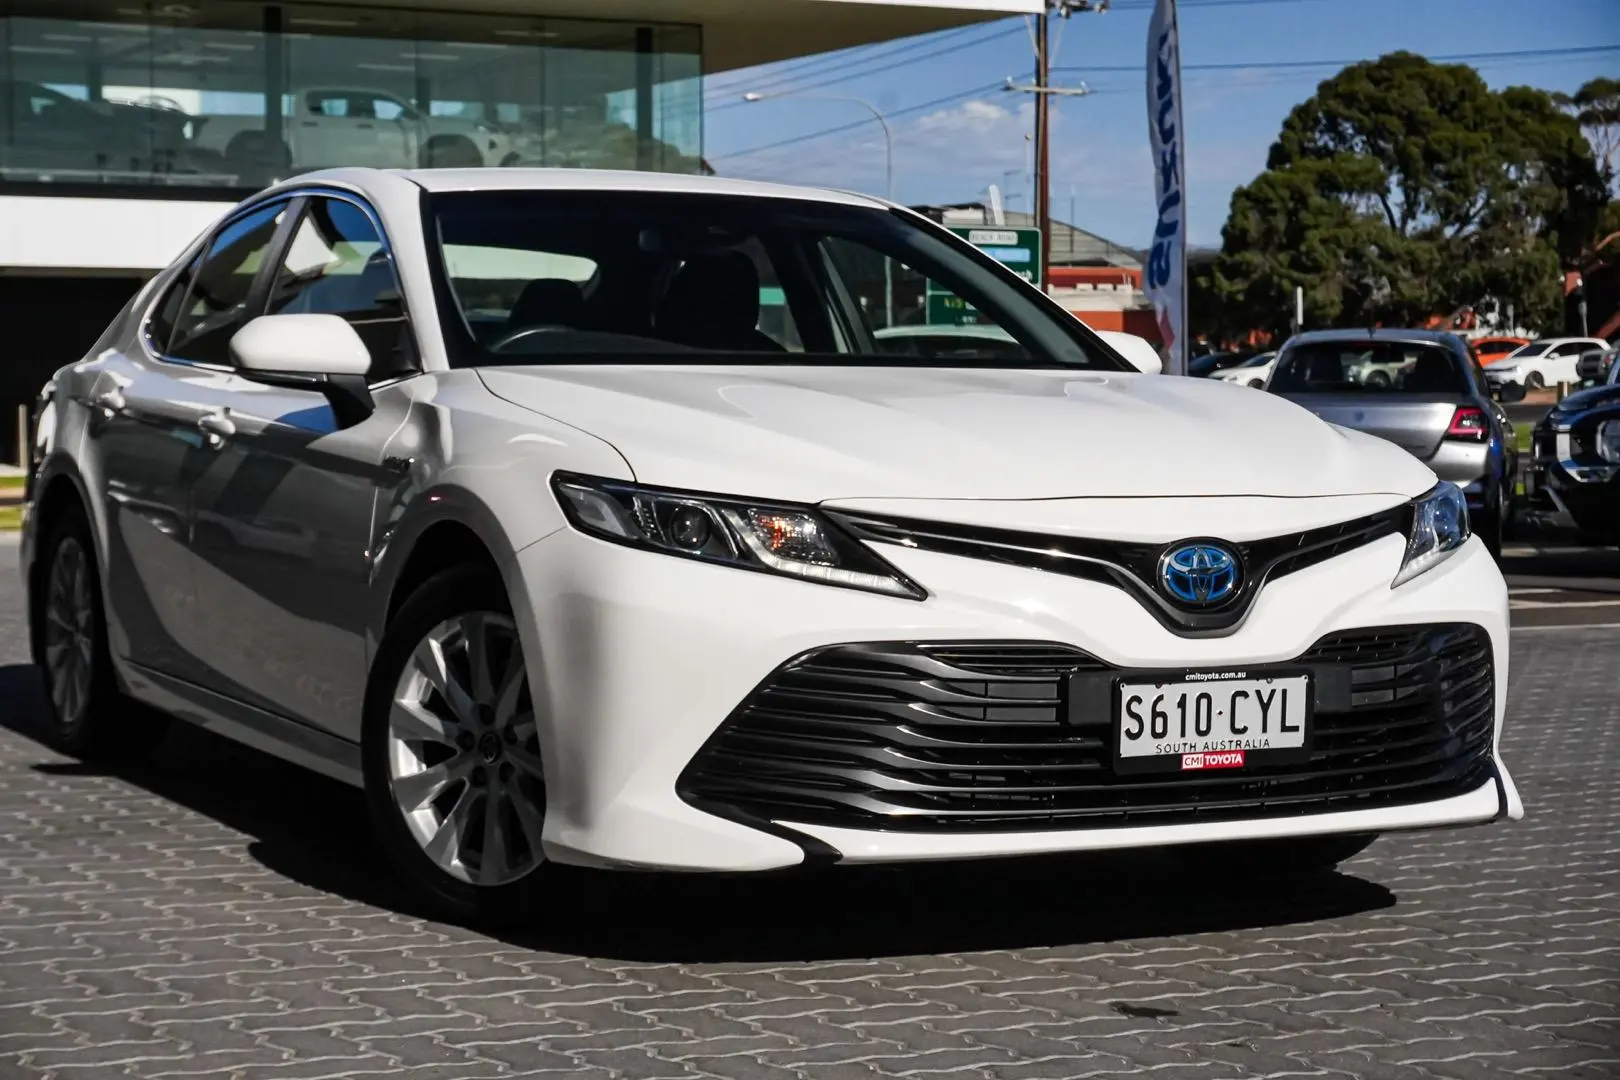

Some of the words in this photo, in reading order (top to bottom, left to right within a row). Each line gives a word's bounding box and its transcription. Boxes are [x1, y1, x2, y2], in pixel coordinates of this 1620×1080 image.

[1185, 671, 1247, 682] cmitoyota.com.au
[1124, 692, 1213, 741] S610
[1230, 688, 1300, 735] CYL
[1156, 742, 1197, 754] SOUTH
[1202, 738, 1270, 751] AUSTRALIA
[1184, 754, 1203, 767] CMI
[1204, 753, 1243, 766] TOYOTA
